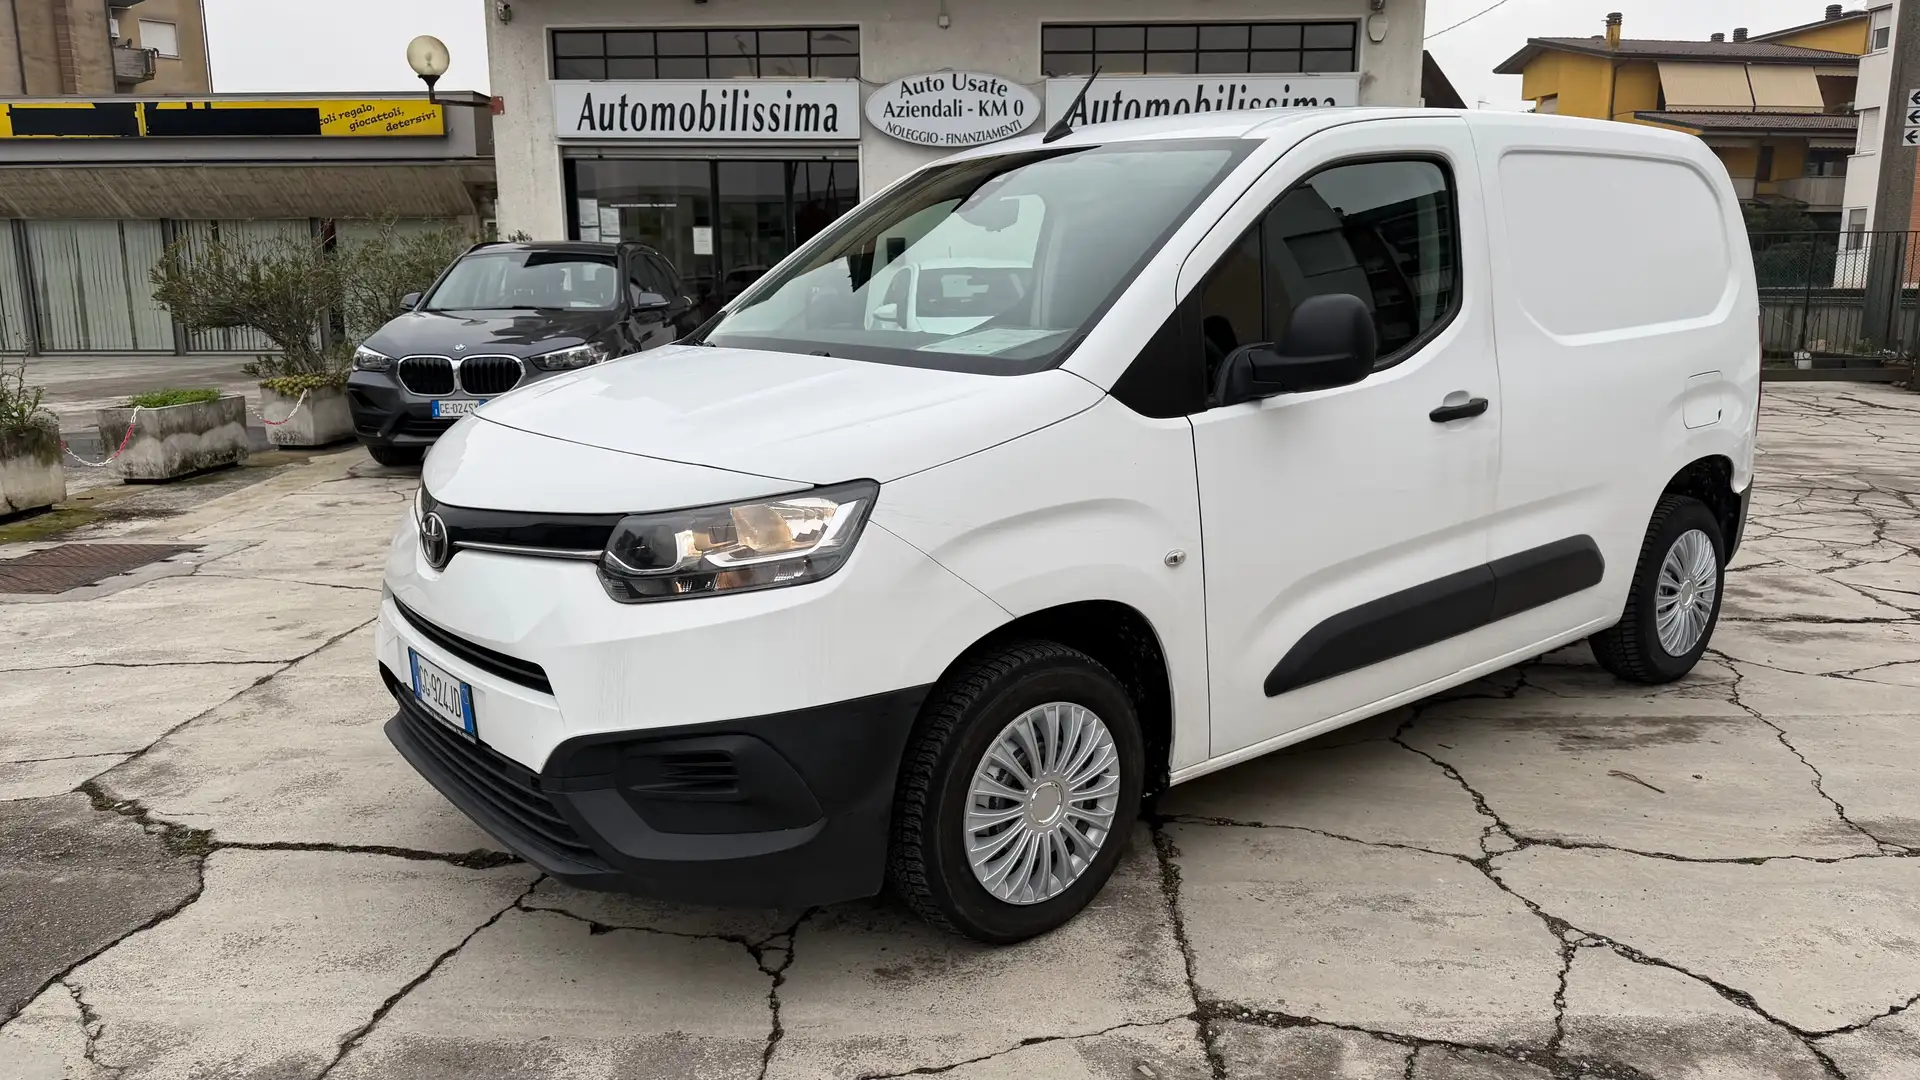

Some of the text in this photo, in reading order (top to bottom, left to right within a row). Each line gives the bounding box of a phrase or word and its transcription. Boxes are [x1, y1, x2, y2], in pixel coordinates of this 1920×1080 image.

[900, 73, 1008, 98] Auto Usate
[338, 104, 375, 119] regalo,
[349, 107, 405, 132] giocattoli,
[386, 109, 437, 132] detersivi
[576, 89, 839, 132] Automobilissima
[883, 99, 963, 118] Aziendali
[978, 100, 1008, 117] KM
[885, 121, 939, 144] NOLEGGIO
[946, 119, 1023, 144] FINANZIAMENTI
